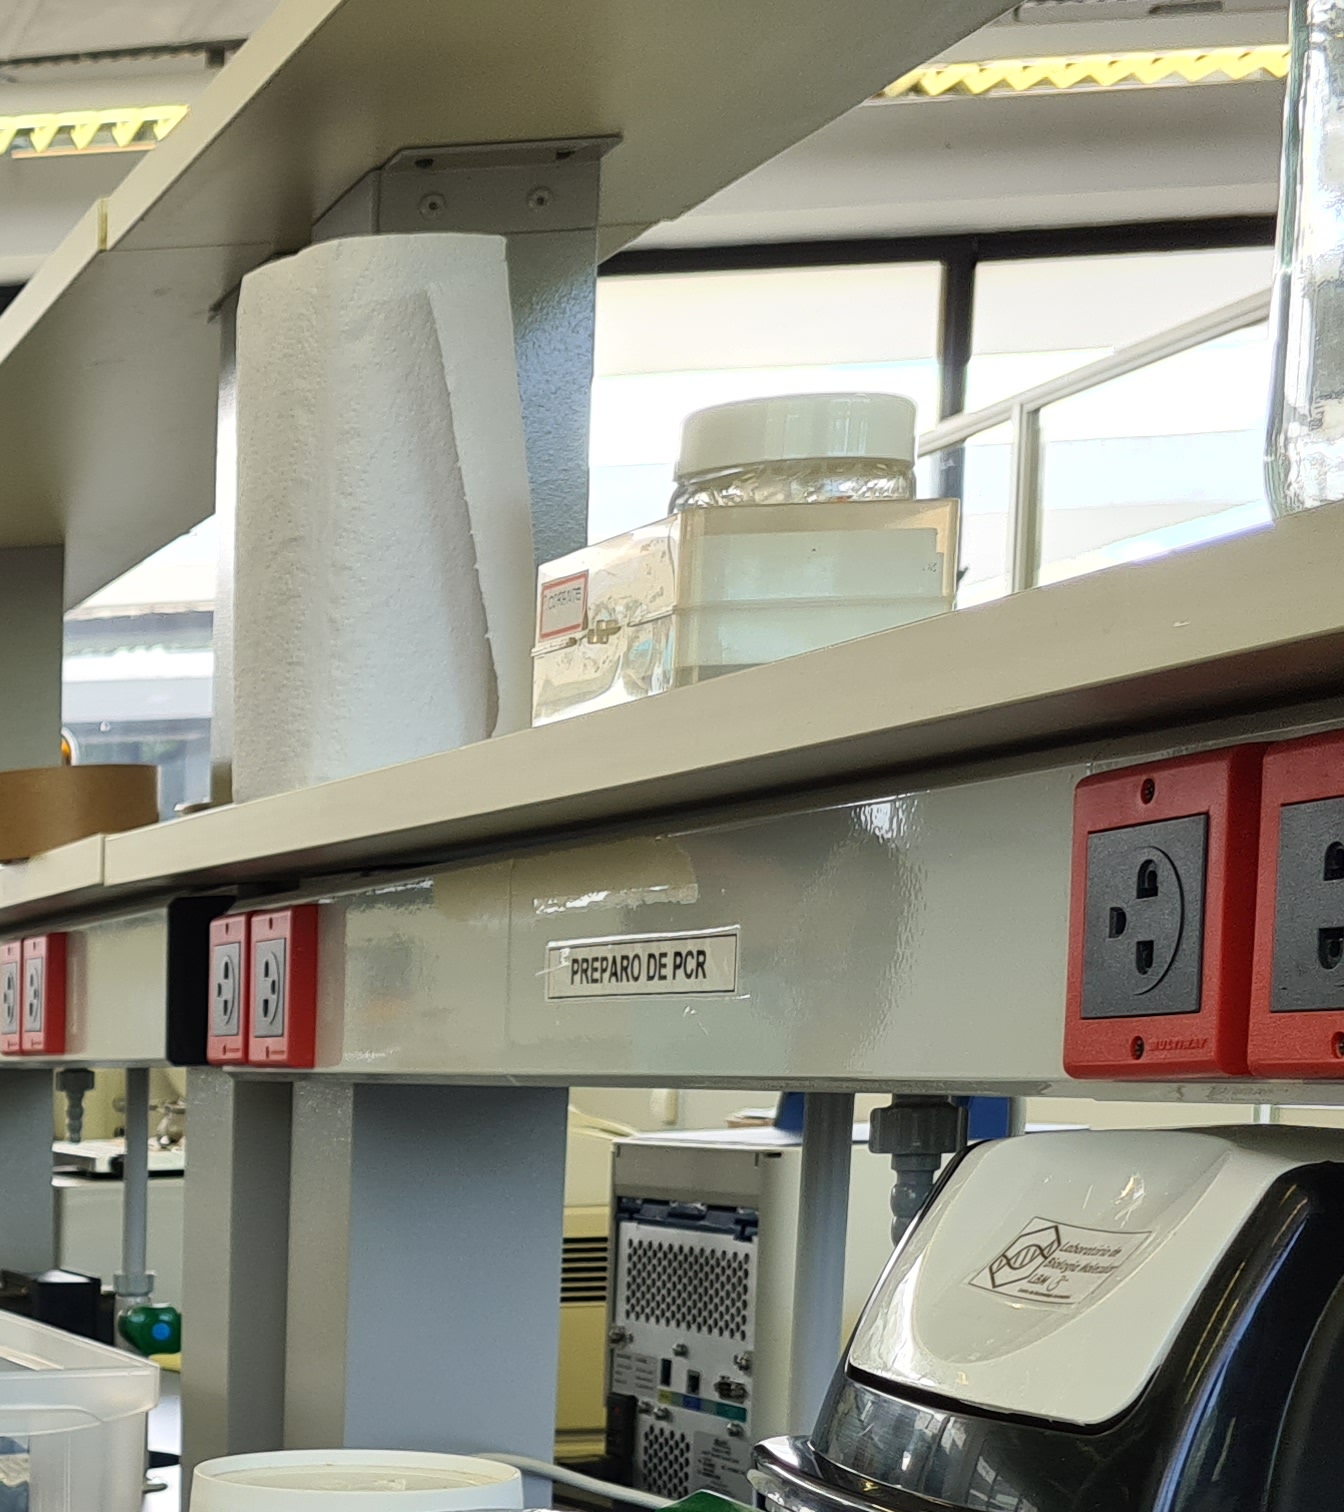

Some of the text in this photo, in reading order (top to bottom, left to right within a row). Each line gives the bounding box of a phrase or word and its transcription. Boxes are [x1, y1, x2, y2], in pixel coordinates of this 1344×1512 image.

[571, 950, 707, 985] PREPARO DE PCR
